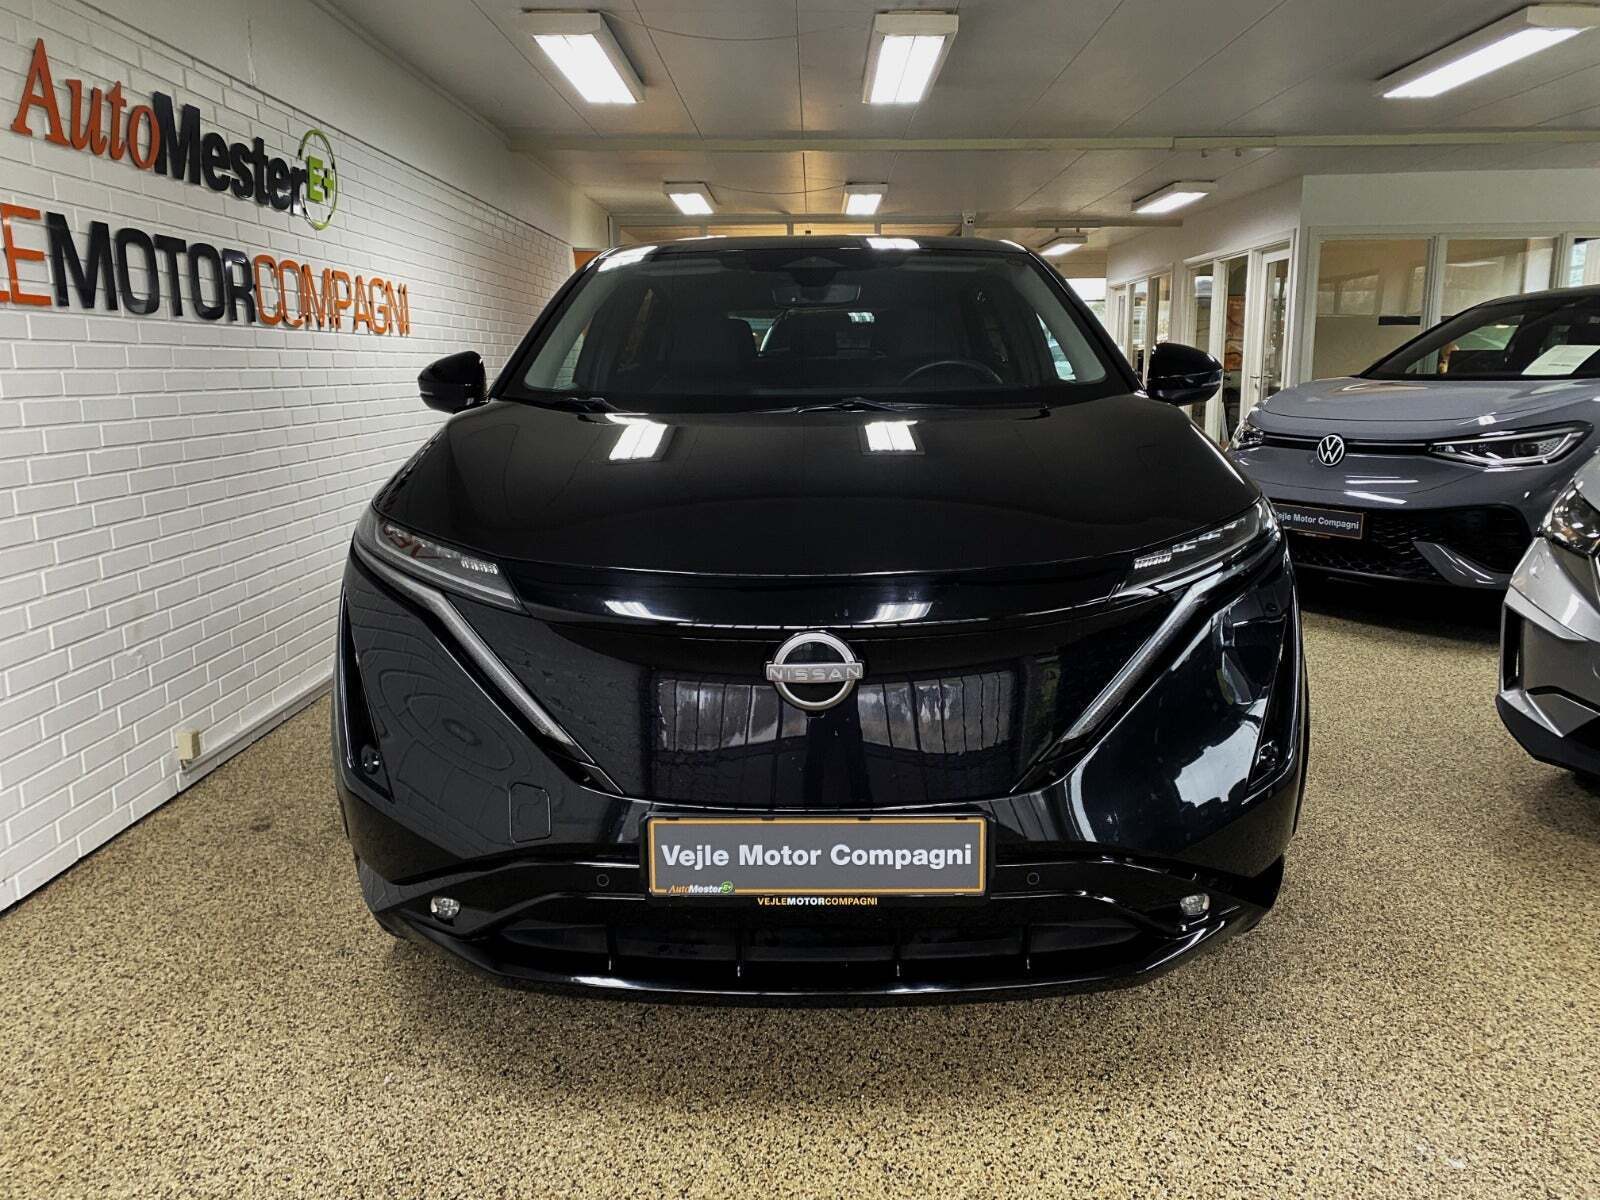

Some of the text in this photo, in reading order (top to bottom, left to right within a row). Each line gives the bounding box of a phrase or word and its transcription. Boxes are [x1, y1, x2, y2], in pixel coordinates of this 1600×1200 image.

[10, 38, 307, 216] AutoMester
[0, 203, 410, 336] EMOTORCOMPAGNI
[1293, 513, 1316, 523] Motor
[1318, 517, 1359, 530] Compagni
[769, 667, 860, 681] NISSAN
[661, 843, 972, 870] Vejle Motor Compagni
